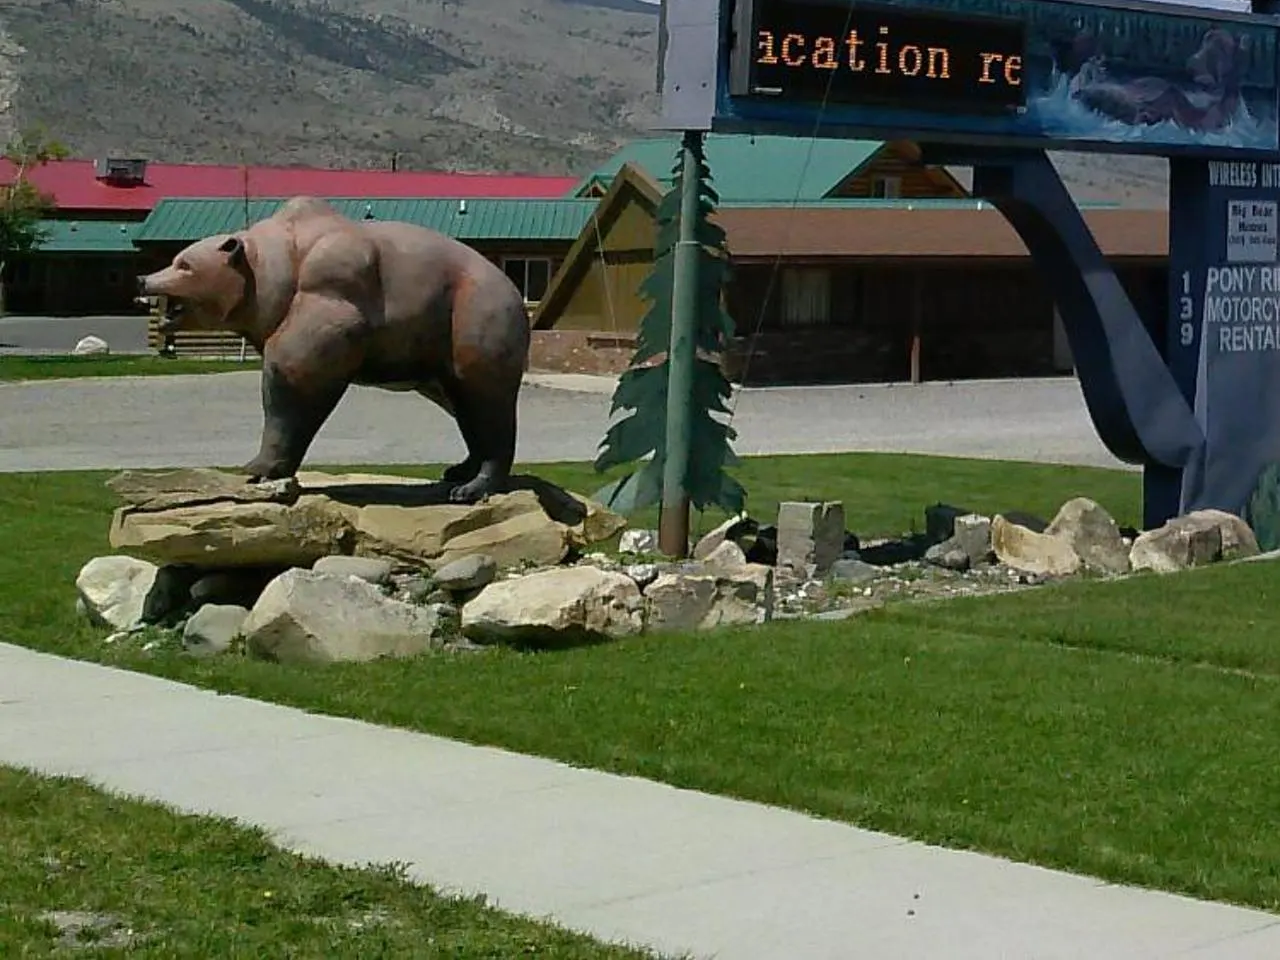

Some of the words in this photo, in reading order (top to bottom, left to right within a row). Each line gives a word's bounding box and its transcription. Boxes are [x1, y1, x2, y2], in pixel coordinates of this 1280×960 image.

[978, 52, 1022, 86] re
[1208, 160, 1258, 188] WIRELESS
[1207, 267, 1259, 292] PONY
